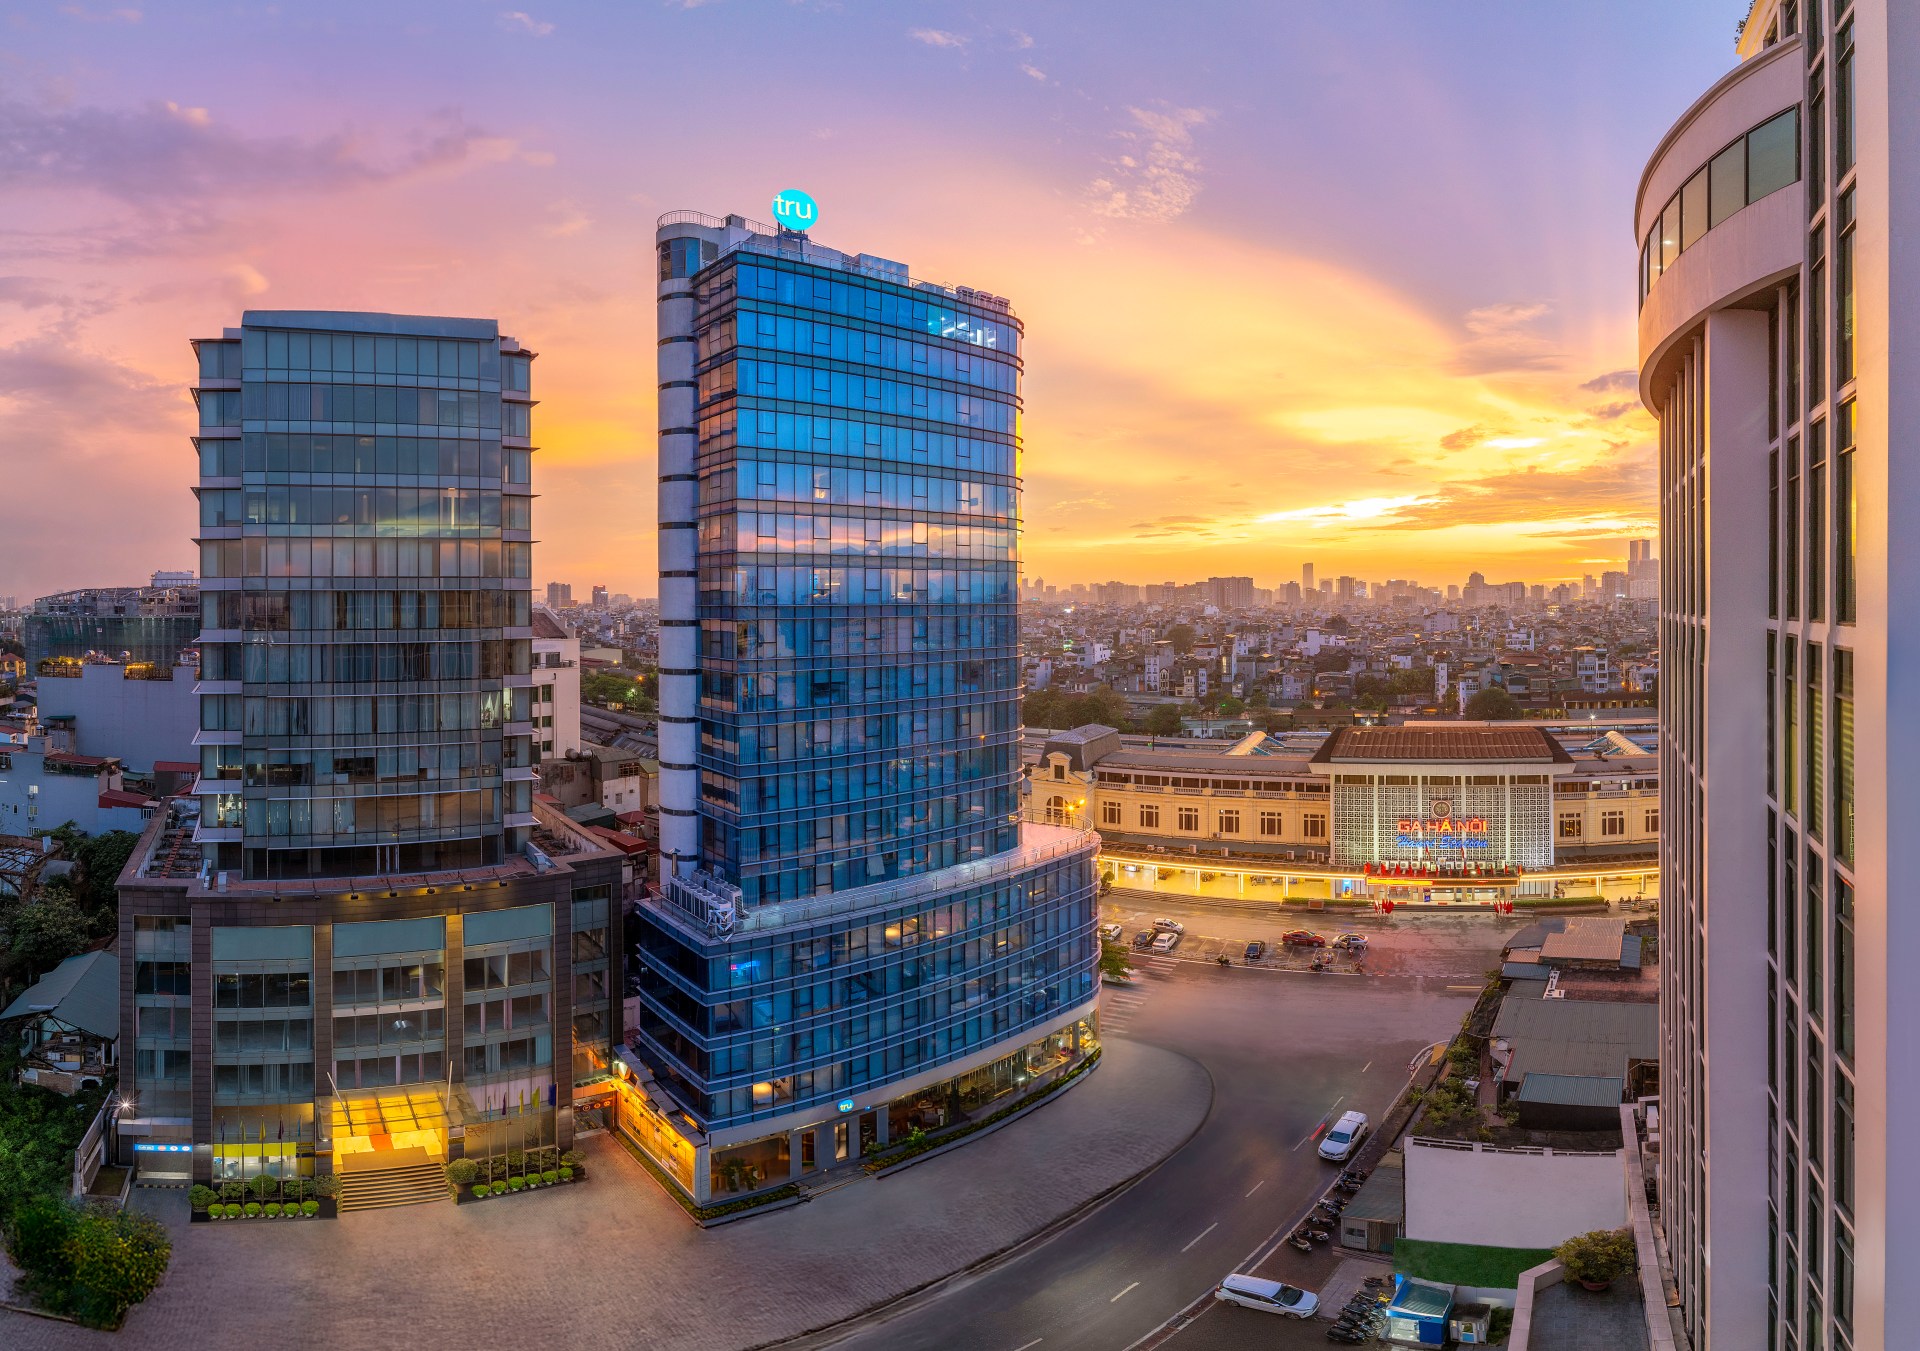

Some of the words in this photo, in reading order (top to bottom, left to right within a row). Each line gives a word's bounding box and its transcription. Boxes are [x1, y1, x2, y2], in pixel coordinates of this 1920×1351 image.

[774, 194, 812, 220] tru
[1397, 820, 1423, 833] GA
[1457, 817, 1487, 834] NỘI
[1440, 835, 1489, 848] Station
[839, 1103, 853, 1111] tru
